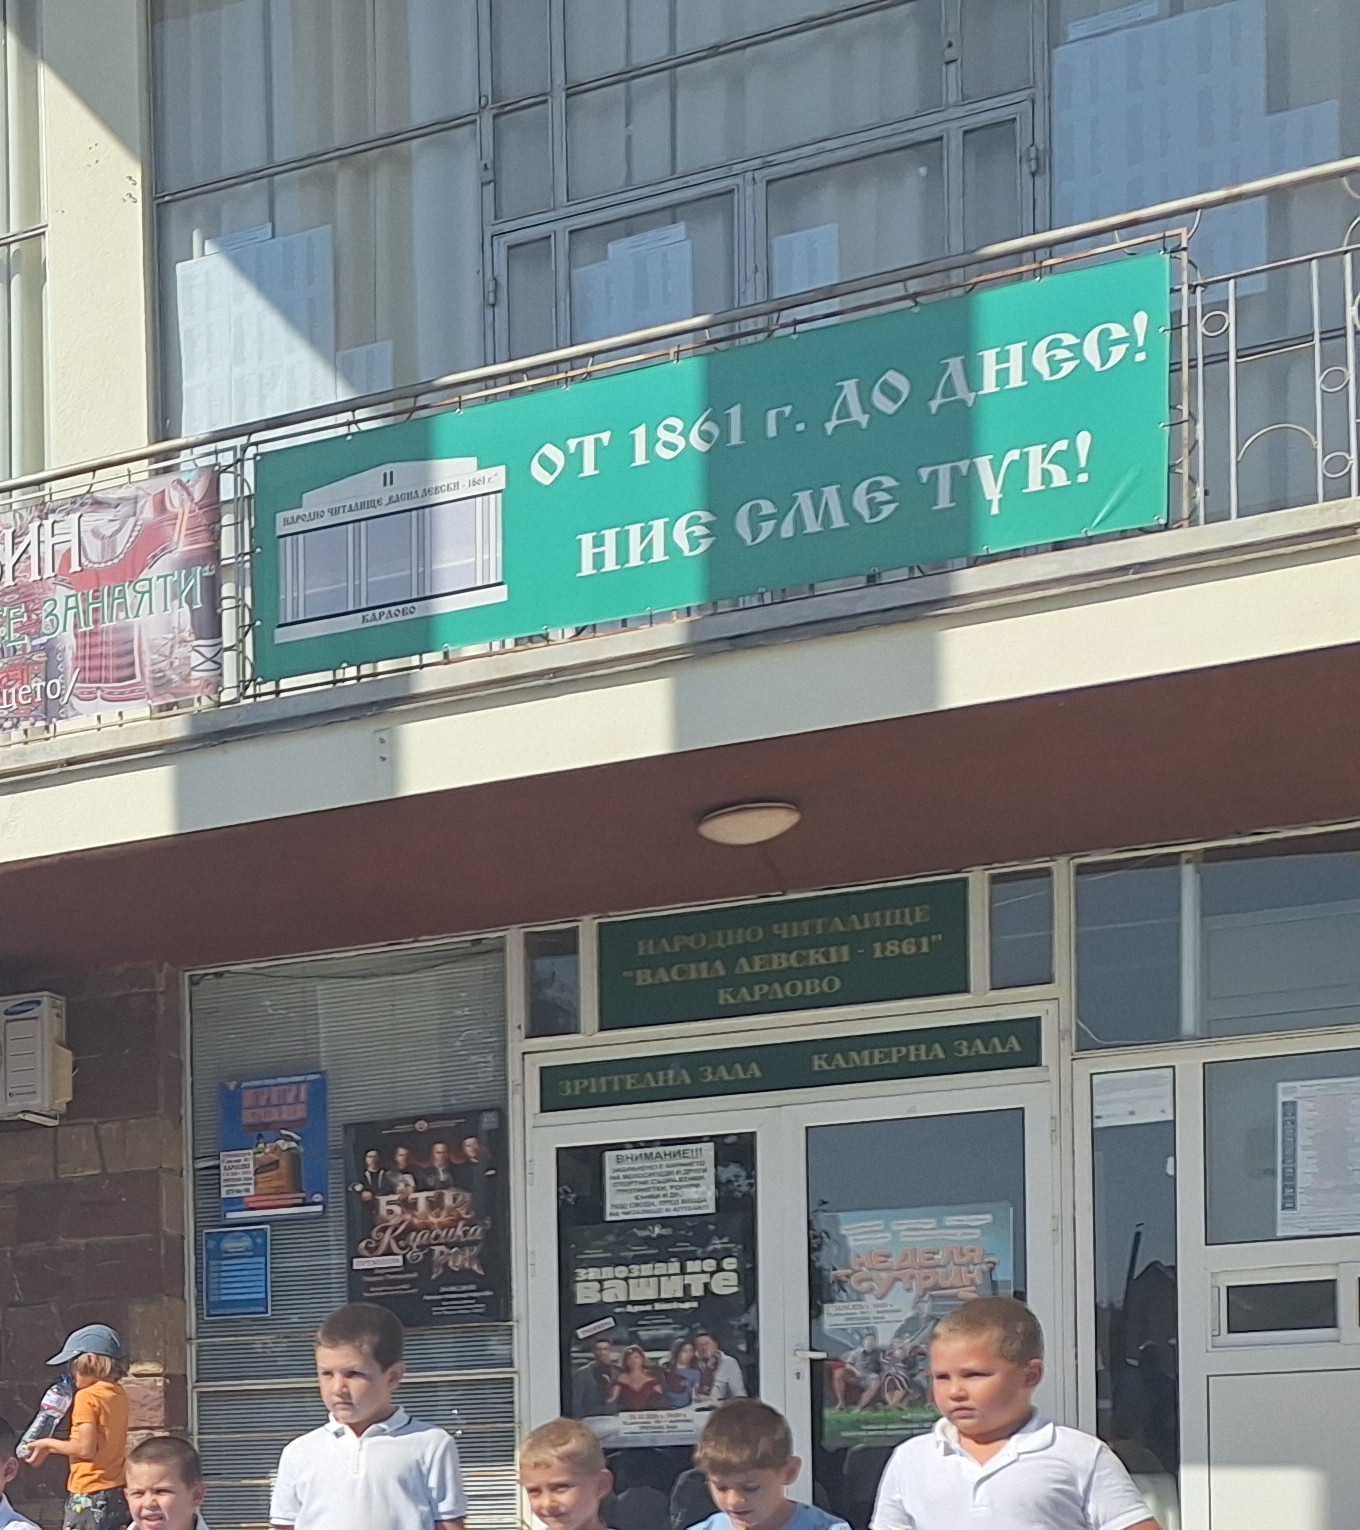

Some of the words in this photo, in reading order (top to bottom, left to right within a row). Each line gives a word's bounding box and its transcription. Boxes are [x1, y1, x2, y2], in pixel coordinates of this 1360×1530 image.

[531, 429, 611, 486] ОТ
[630, 401, 743, 467] 1861
[765, 406, 806, 439] г.
[824, 368, 910, 436] ДО
[928, 311, 1148, 415] ДНЕС!
[576, 510, 714, 576] НИЕ
[735, 478, 902, 546] СМЕ
[917, 430, 1092, 516] ТУК!
[362, 606, 416, 624] КАРЛОВО
[637, 924, 764, 956] НАРОДНО
[772, 905, 931, 938] ЧИТАЛИЩЕ
[734, 944, 851, 975] ЛЕВСКИ
[717, 975, 842, 1006] КАРЛОВО
[811, 1042, 946, 1072] КАМЕРНА
[953, 1033, 1022, 1057] ЗАЛА
[557, 1066, 692, 1097] ЗРИТЕЛНА
[699, 1061, 762, 1084] ЗАЛА
[851, 1244, 985, 1271] НЕДЕЛЯ
[850, 1267, 984, 1300] СУТРИН
